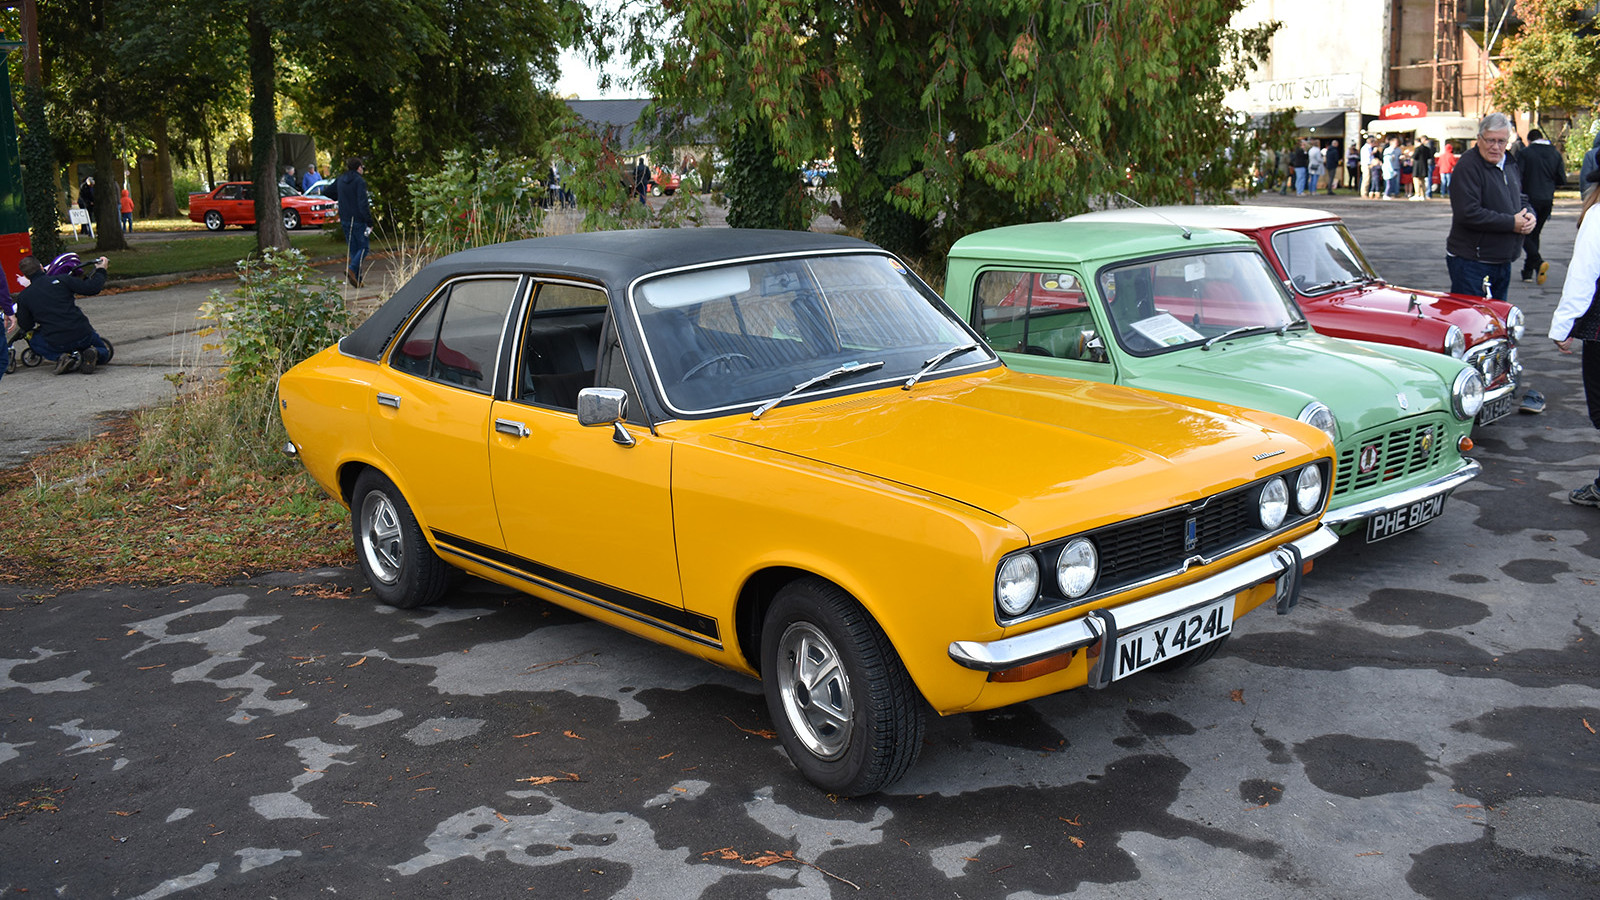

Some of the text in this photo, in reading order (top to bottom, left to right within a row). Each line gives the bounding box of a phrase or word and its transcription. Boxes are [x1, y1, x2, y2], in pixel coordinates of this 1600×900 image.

[1269, 79, 1333, 102] COW SOW
[71, 210, 85, 218] WC
[1372, 494, 1444, 539] PHE 812M
[1119, 606, 1229, 675] NLX 424L
